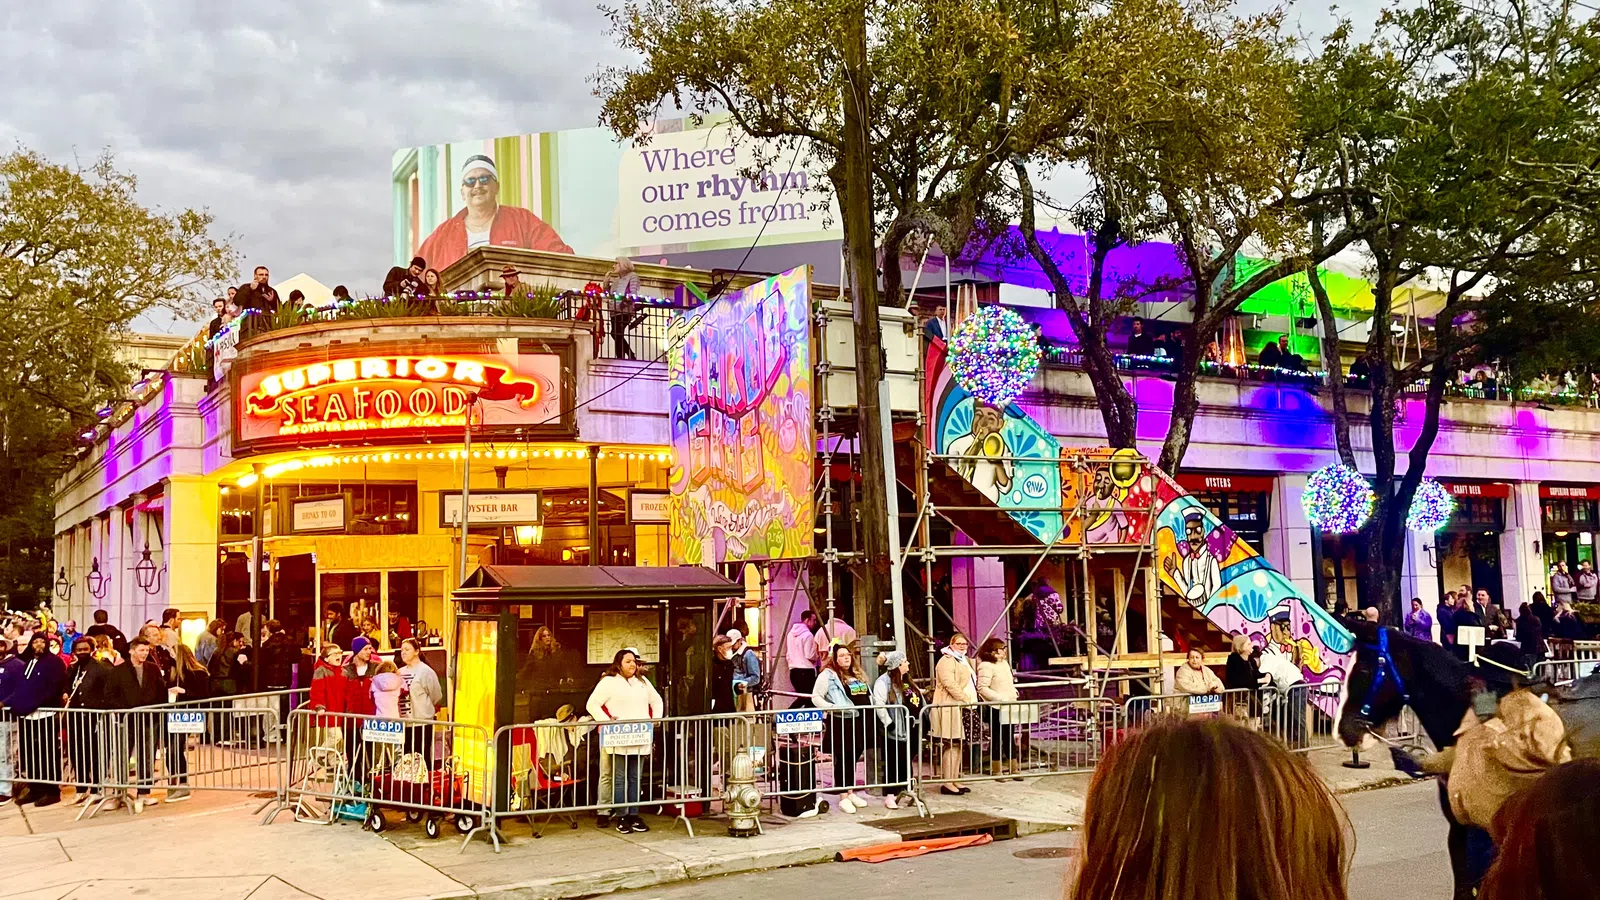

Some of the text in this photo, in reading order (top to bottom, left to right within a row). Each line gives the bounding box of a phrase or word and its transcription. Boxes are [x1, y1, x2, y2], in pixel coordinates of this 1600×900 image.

[641, 146, 736, 172] Where
[642, 169, 809, 203] our rhythm
[642, 207, 732, 233] comes
[262, 356, 486, 396] SUPERIOR
[280, 387, 468, 425] SEAFOOD
[382, 416, 411, 430] NEW
[1204, 477, 1232, 488] OYSTERS
[1453, 485, 1468, 495] CRAFT
[321, 510, 328, 519] TO
[329, 509, 337, 518] GO
[500, 503, 518, 512] BAR
[640, 503, 668, 511] FROZEN
